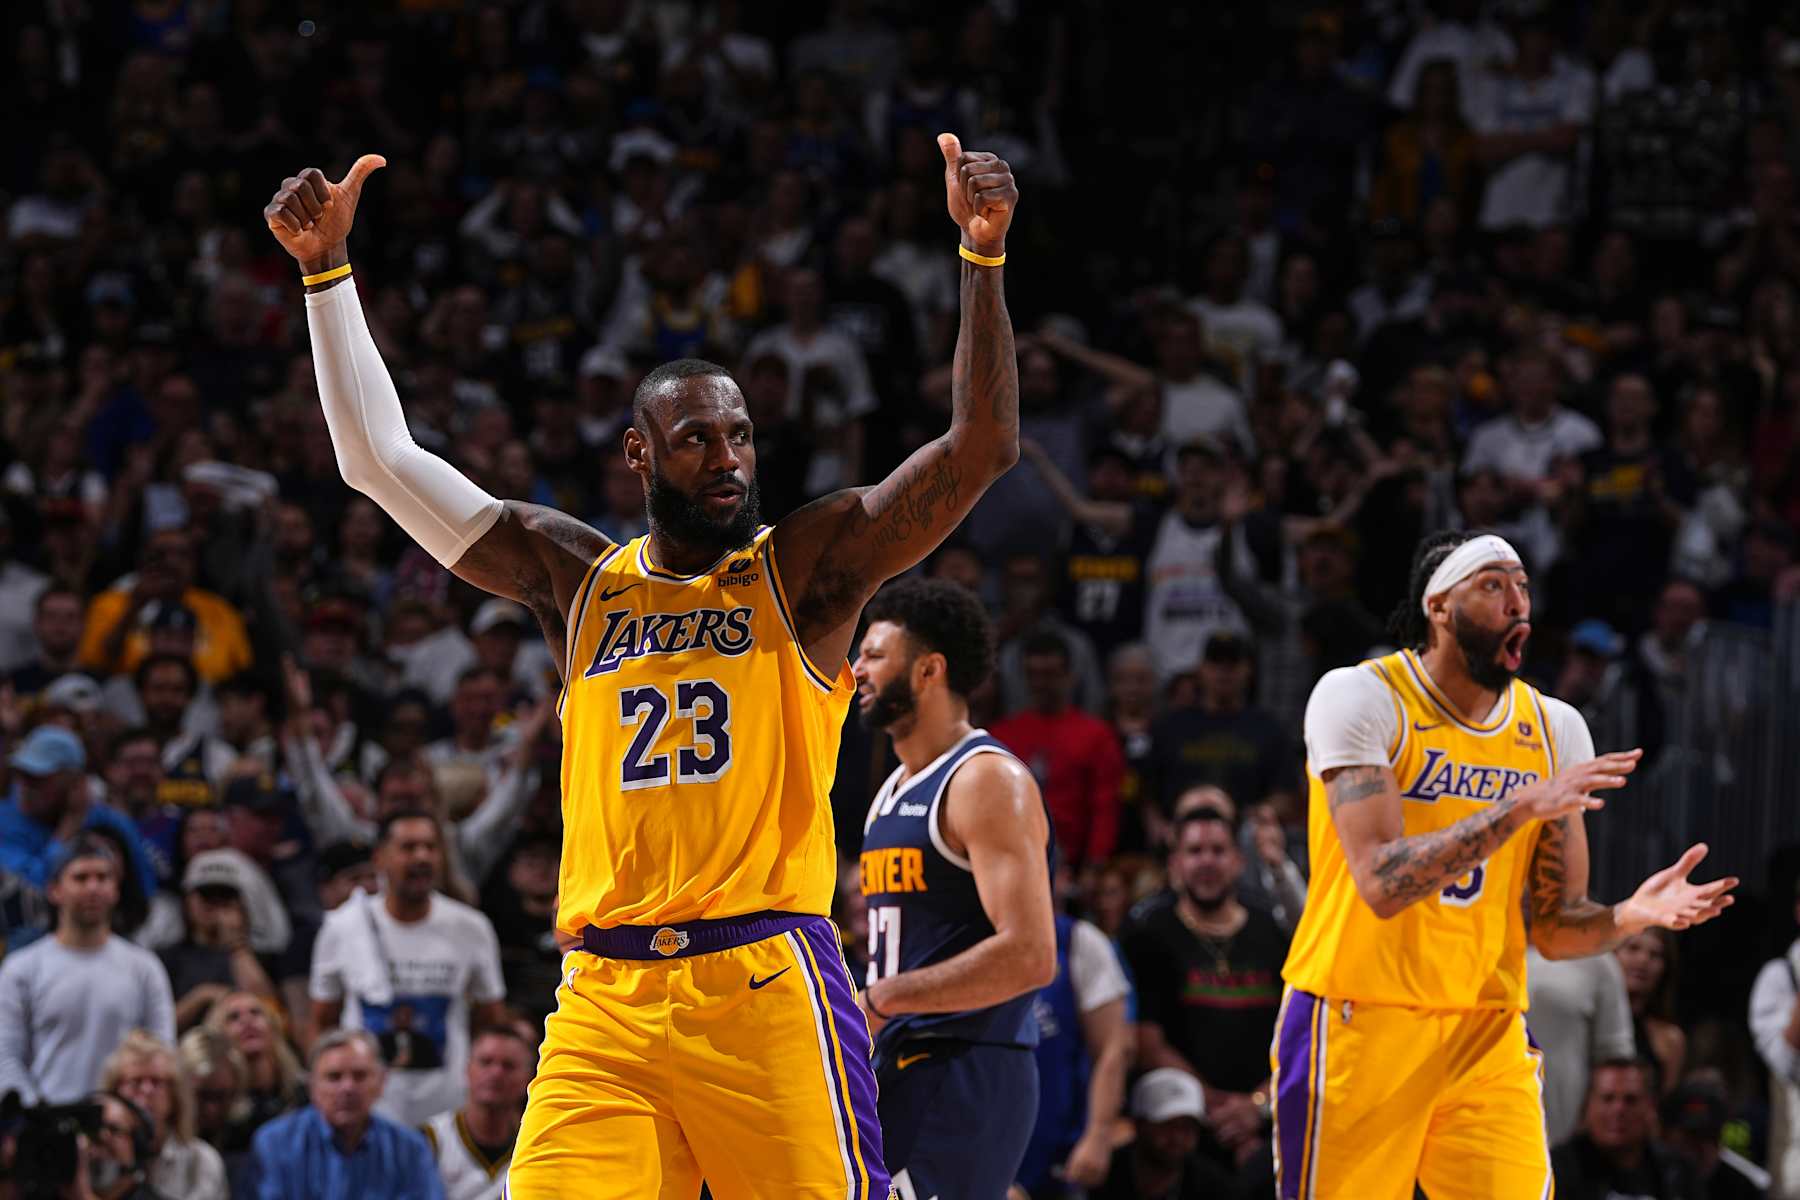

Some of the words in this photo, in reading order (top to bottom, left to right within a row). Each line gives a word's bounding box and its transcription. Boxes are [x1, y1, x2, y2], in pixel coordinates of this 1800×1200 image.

[718, 572, 759, 587] bibigo
[584, 607, 755, 681] LAKERS
[619, 678, 733, 792] 23
[649, 930, 690, 951] LAKERS
